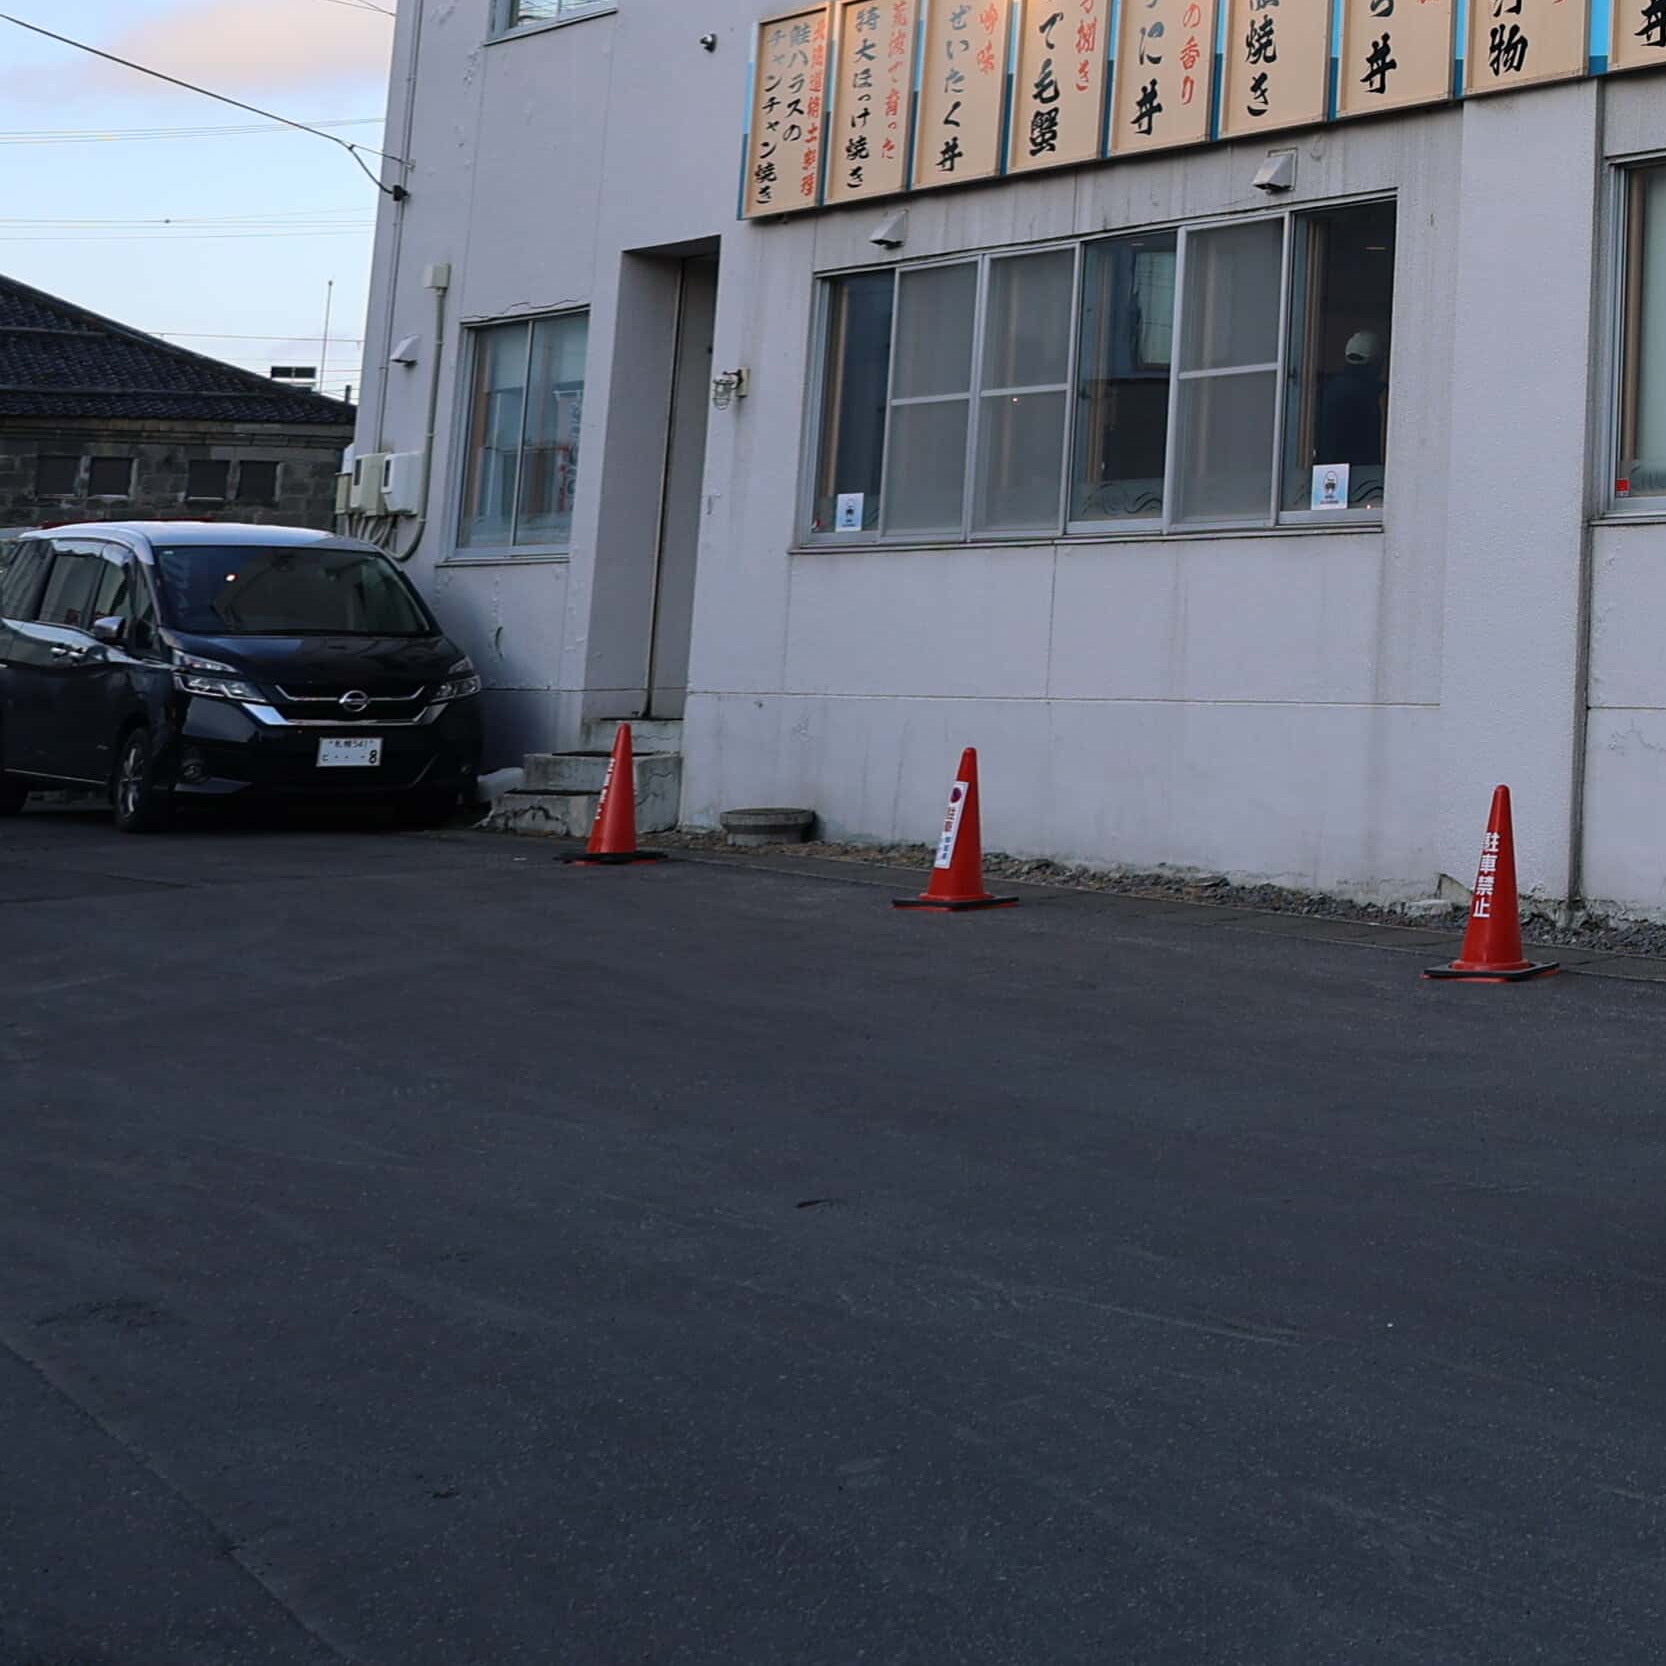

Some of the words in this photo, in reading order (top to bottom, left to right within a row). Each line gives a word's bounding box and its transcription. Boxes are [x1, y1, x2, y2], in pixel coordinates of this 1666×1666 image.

[754, 31, 787, 204] チャンチャン焼き
[783, 23, 810, 141] 鮭ハラスの
[845, 6, 880, 188] 特大ほっけ焼き
[1473, 832, 1500, 918] 駐車禁止
